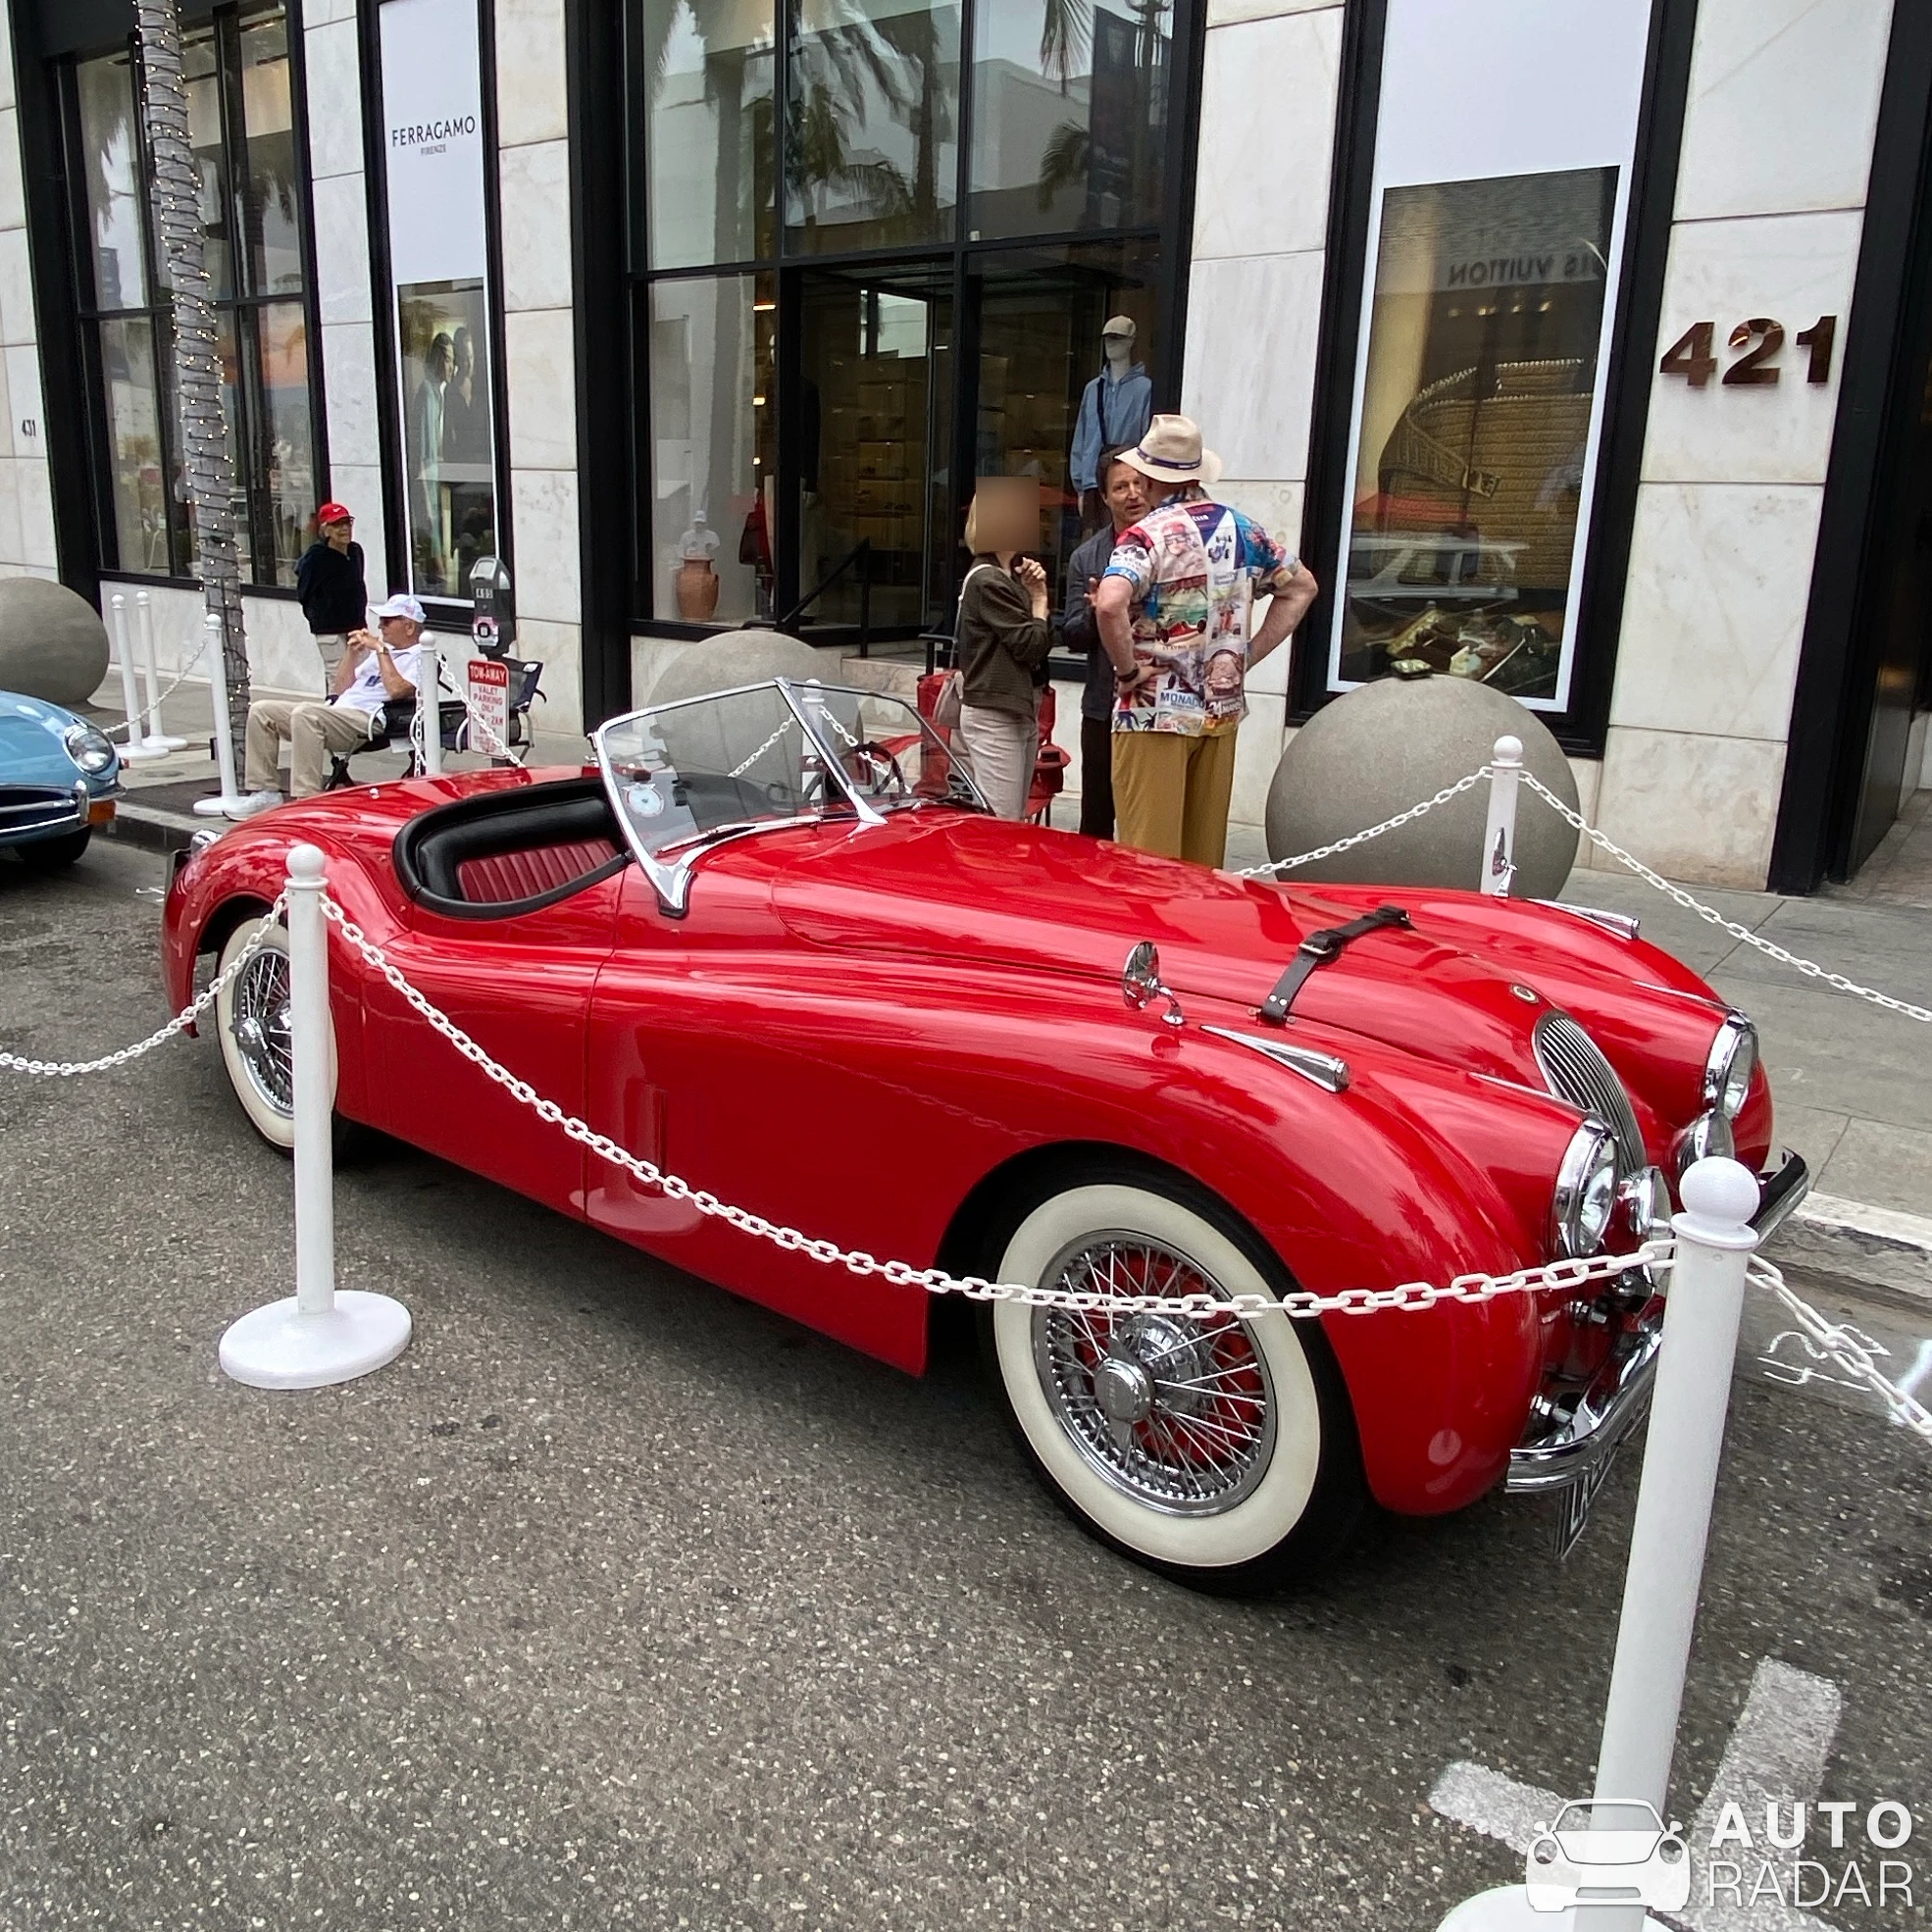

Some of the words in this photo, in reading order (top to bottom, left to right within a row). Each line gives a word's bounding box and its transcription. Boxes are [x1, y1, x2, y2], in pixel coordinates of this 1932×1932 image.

[391, 116, 476, 148] FERRAGAMO
[420, 143, 447, 156] FIRENZE
[1659, 316, 1837, 386] 421
[469, 665, 506, 684] TOW-AWAY
[479, 685, 499, 695] VALET
[474, 693, 503, 706] PARKING
